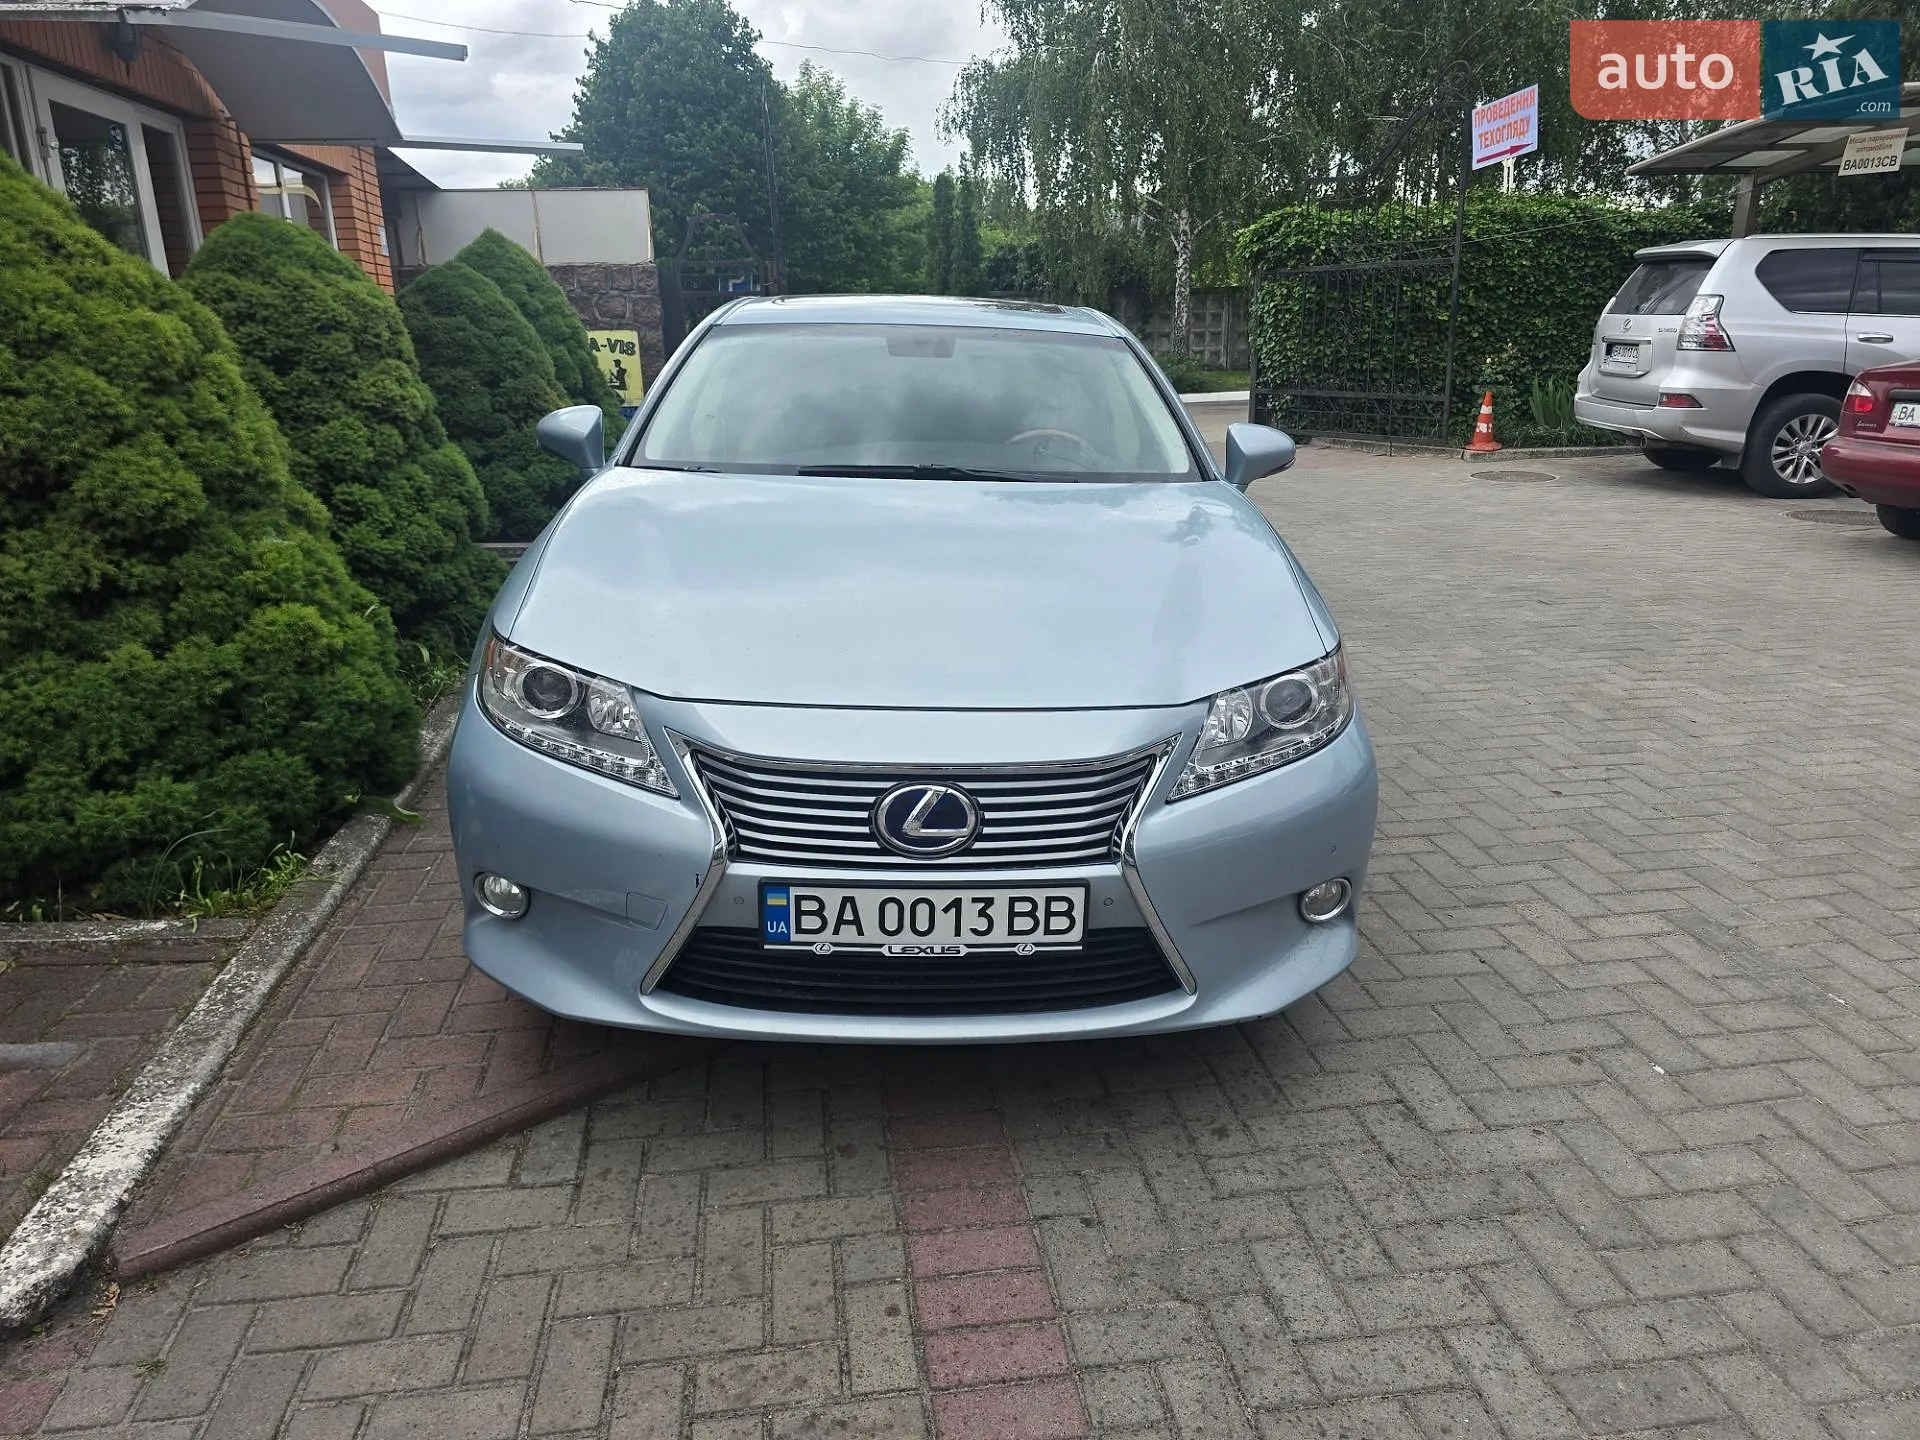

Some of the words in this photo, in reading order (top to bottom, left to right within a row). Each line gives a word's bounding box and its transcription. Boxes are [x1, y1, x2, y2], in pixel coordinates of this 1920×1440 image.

[1474, 88, 1536, 129] ПРОВЕДЕННЯ
[1478, 114, 1531, 149] ТЕХОГЛЯДУ
[767, 920, 788, 934] UA
[794, 894, 865, 936] BA
[878, 896, 995, 937] 0013
[1008, 895, 1077, 936] BB
[888, 945, 961, 955] LEXUS
